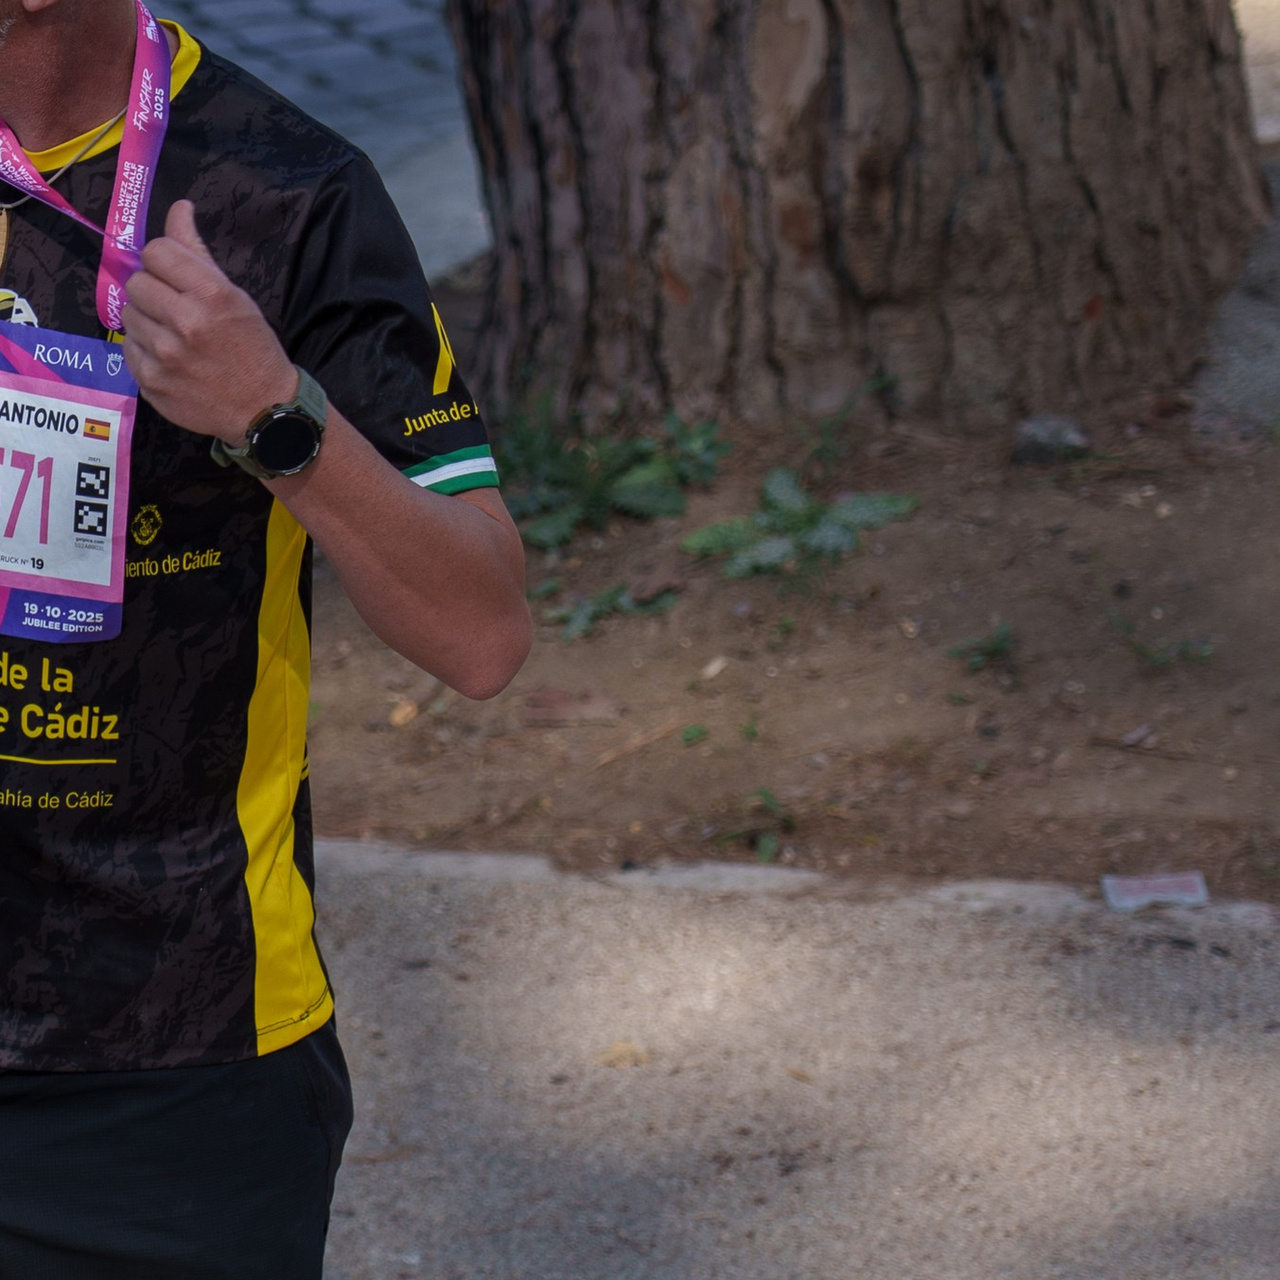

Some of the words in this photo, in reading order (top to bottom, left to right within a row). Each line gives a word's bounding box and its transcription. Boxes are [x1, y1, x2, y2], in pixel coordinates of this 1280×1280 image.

[132, 67, 153, 132] FINISHER
[153, 87, 165, 120] 2025
[122, 161, 131, 179] AIR
[117, 180, 128, 207] WIZZ
[121, 192, 133, 223] ROME
[128, 163, 137, 191] HALF
[127, 164, 145, 225] MARATHON
[33, 343, 93, 372] ROMA
[403, 408, 450, 437] Junta
[449, 401, 471, 422] de
[30, 557, 45, 570] 19
[125, 558, 159, 578] iento
[161, 554, 180, 575] de
[182, 548, 221, 571] Cádiz
[22, 617, 61, 631] JUBILEE
[62, 623, 103, 633] EDITION
[41, 658, 74, 693] la
[20, 702, 120, 740] Cádiz
[37, 791, 60, 809] de
[65, 788, 115, 810] Cádiz
